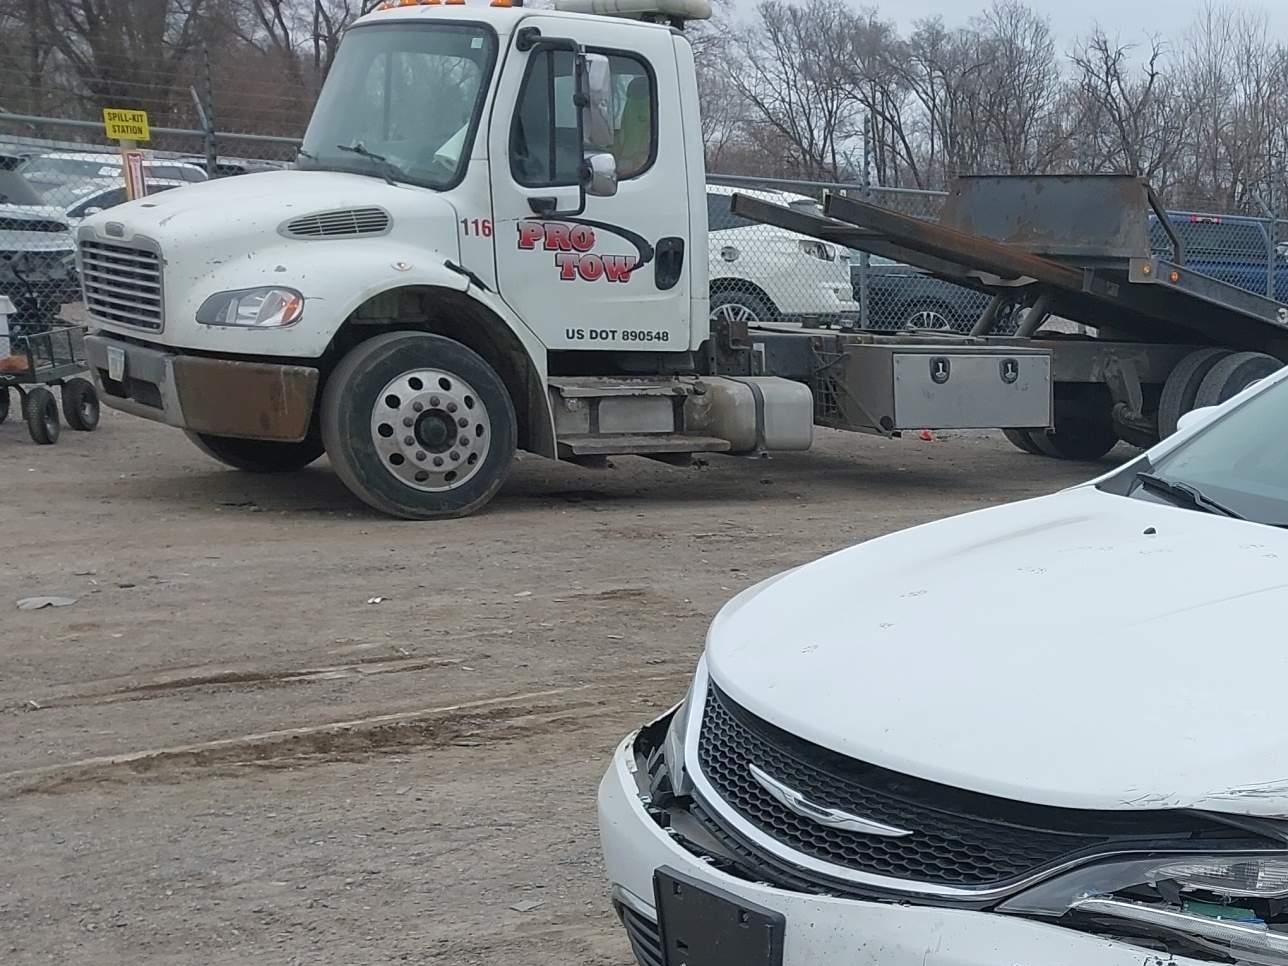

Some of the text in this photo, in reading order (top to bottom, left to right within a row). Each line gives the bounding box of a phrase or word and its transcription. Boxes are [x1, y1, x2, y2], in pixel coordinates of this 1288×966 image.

[107, 112, 144, 123] SPILL-KIT
[112, 125, 143, 135] STATION
[460, 218, 493, 237] 116
[517, 221, 596, 252] PRO
[554, 253, 637, 283] TOW
[565, 329, 670, 342] US DOT 890548
